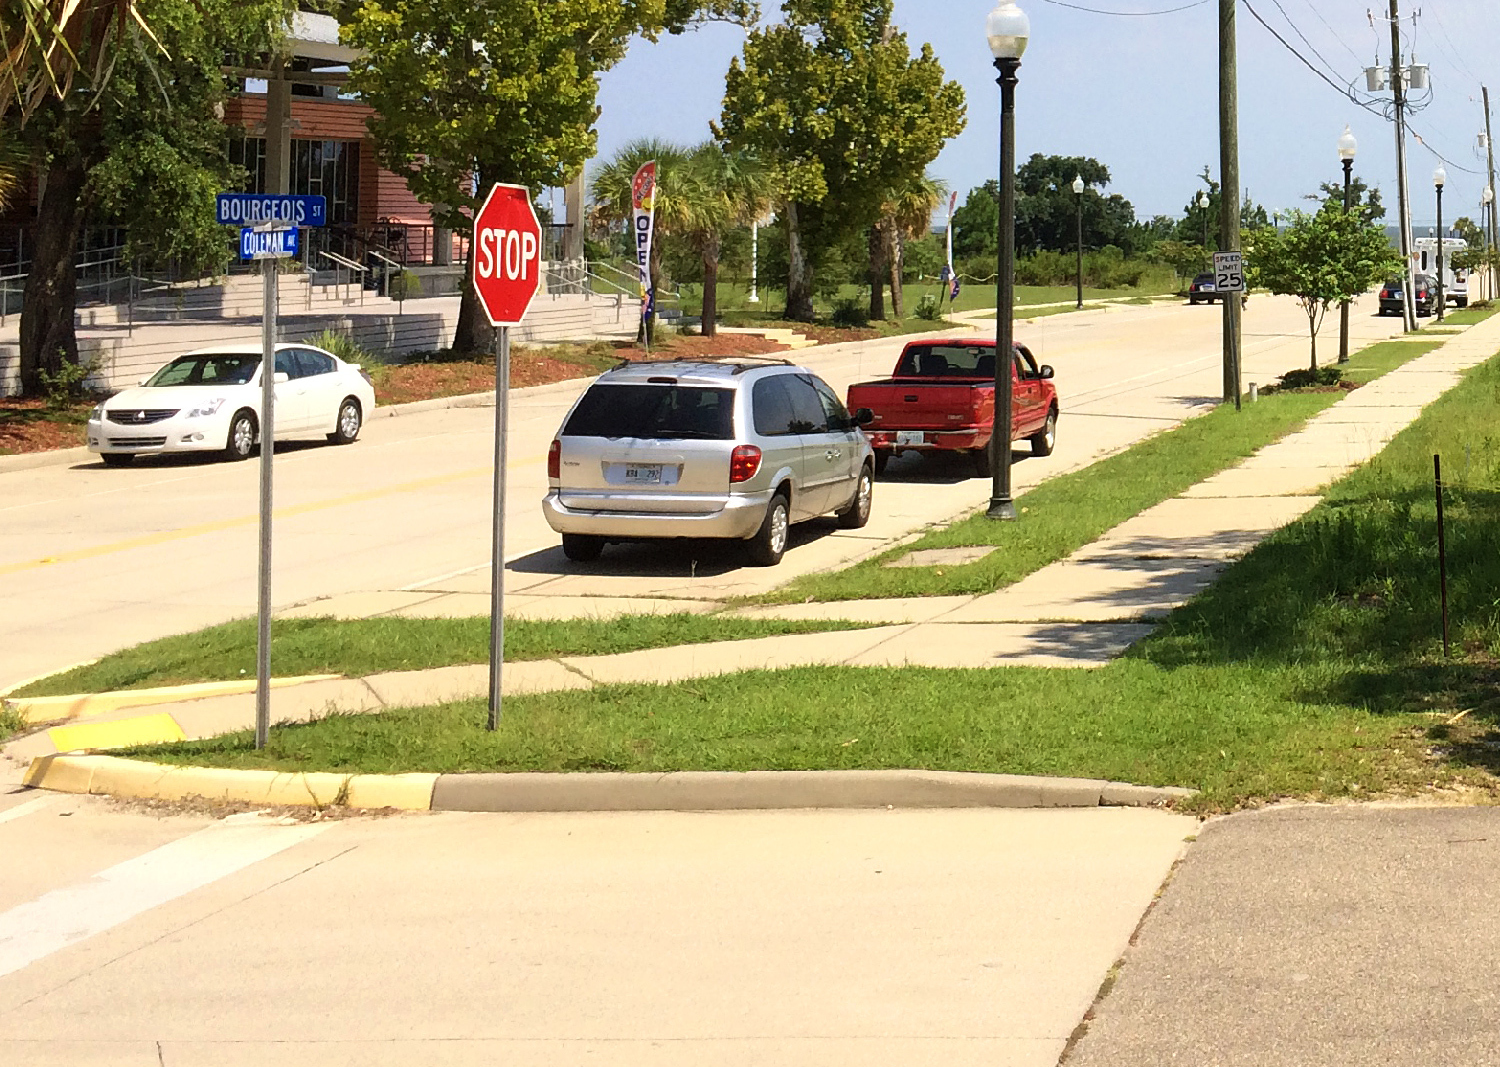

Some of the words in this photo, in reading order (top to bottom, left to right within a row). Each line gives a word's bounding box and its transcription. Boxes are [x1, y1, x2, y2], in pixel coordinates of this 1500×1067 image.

[220, 198, 306, 222] BOURGEOIS
[312, 205, 322, 217] ST
[243, 232, 284, 255] COLEMAN
[287, 234, 296, 247] AVE
[478, 227, 537, 280] STOP
[1217, 273, 1242, 288] 25
